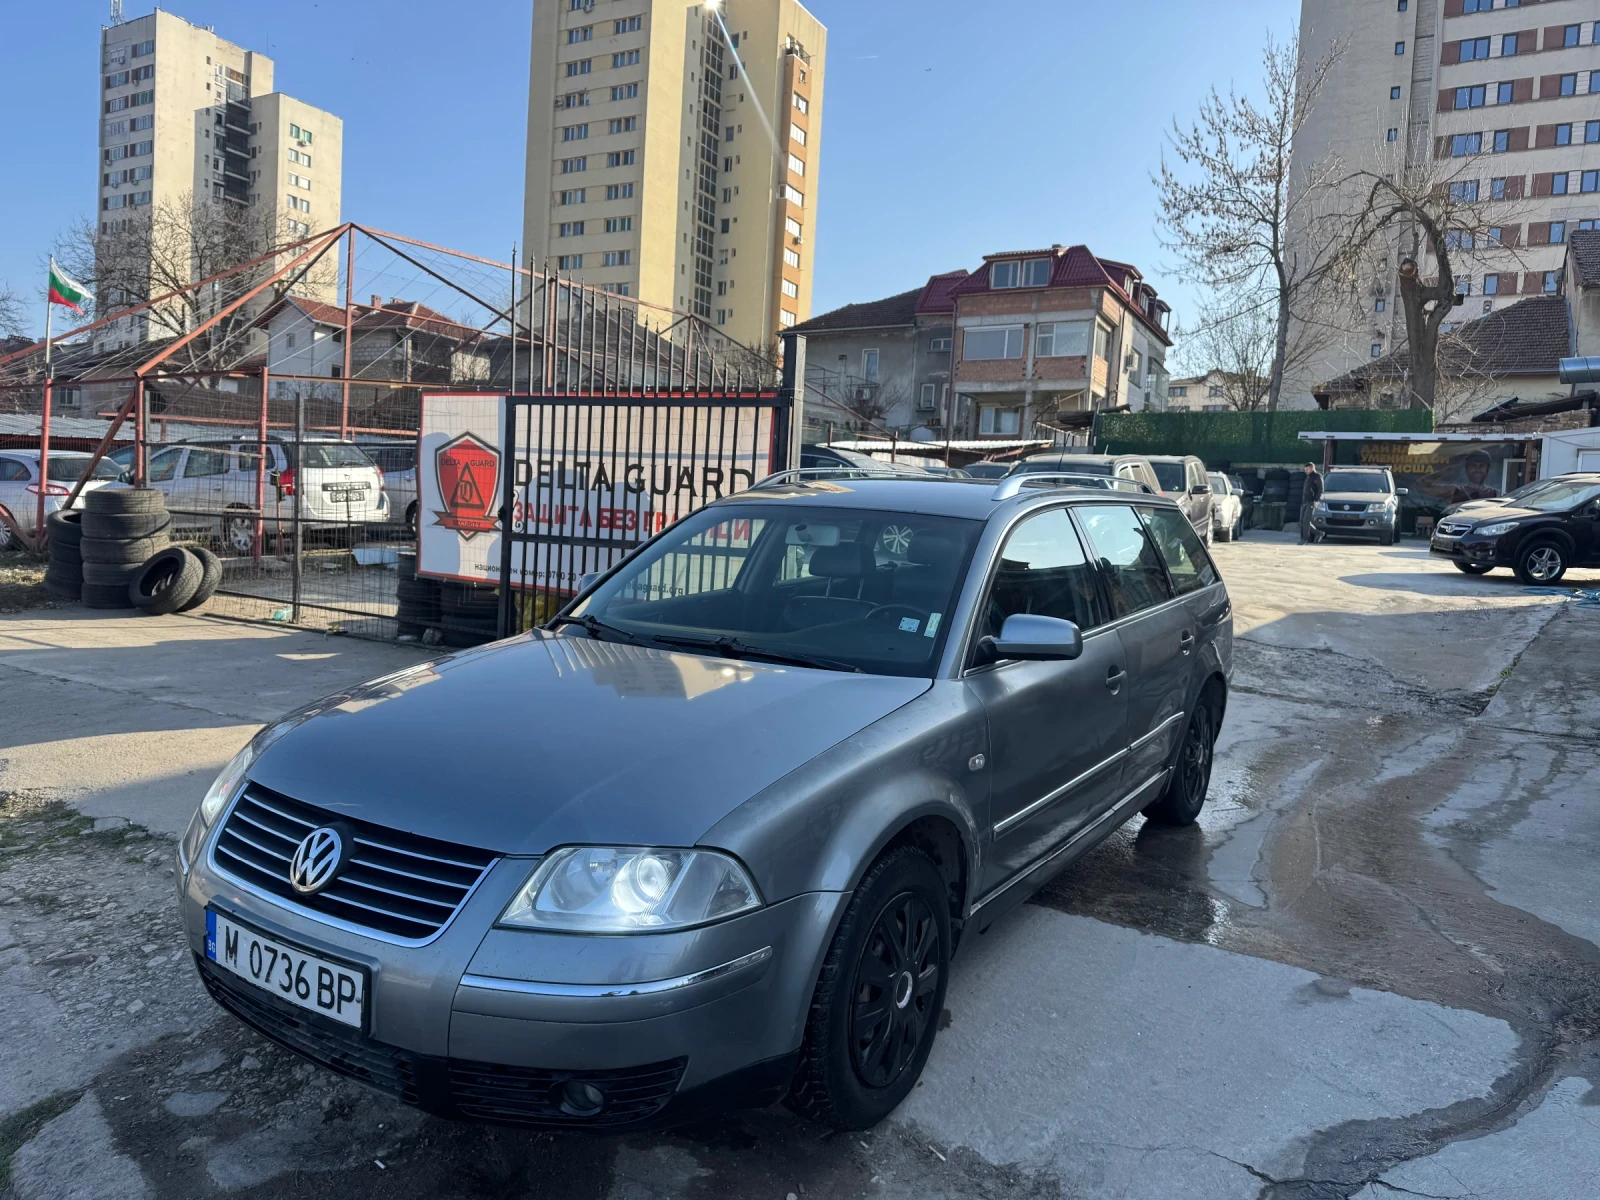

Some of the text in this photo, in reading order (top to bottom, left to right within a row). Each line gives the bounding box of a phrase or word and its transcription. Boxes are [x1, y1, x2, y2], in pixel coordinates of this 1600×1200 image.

[515, 459, 754, 499] DELTA GUARD
[453, 520, 481, 528] SECURITY
[600, 507, 636, 531] БЕЗ
[474, 563, 518, 576] национен
[225, 925, 239, 968] M
[250, 940, 310, 1000] 0736
